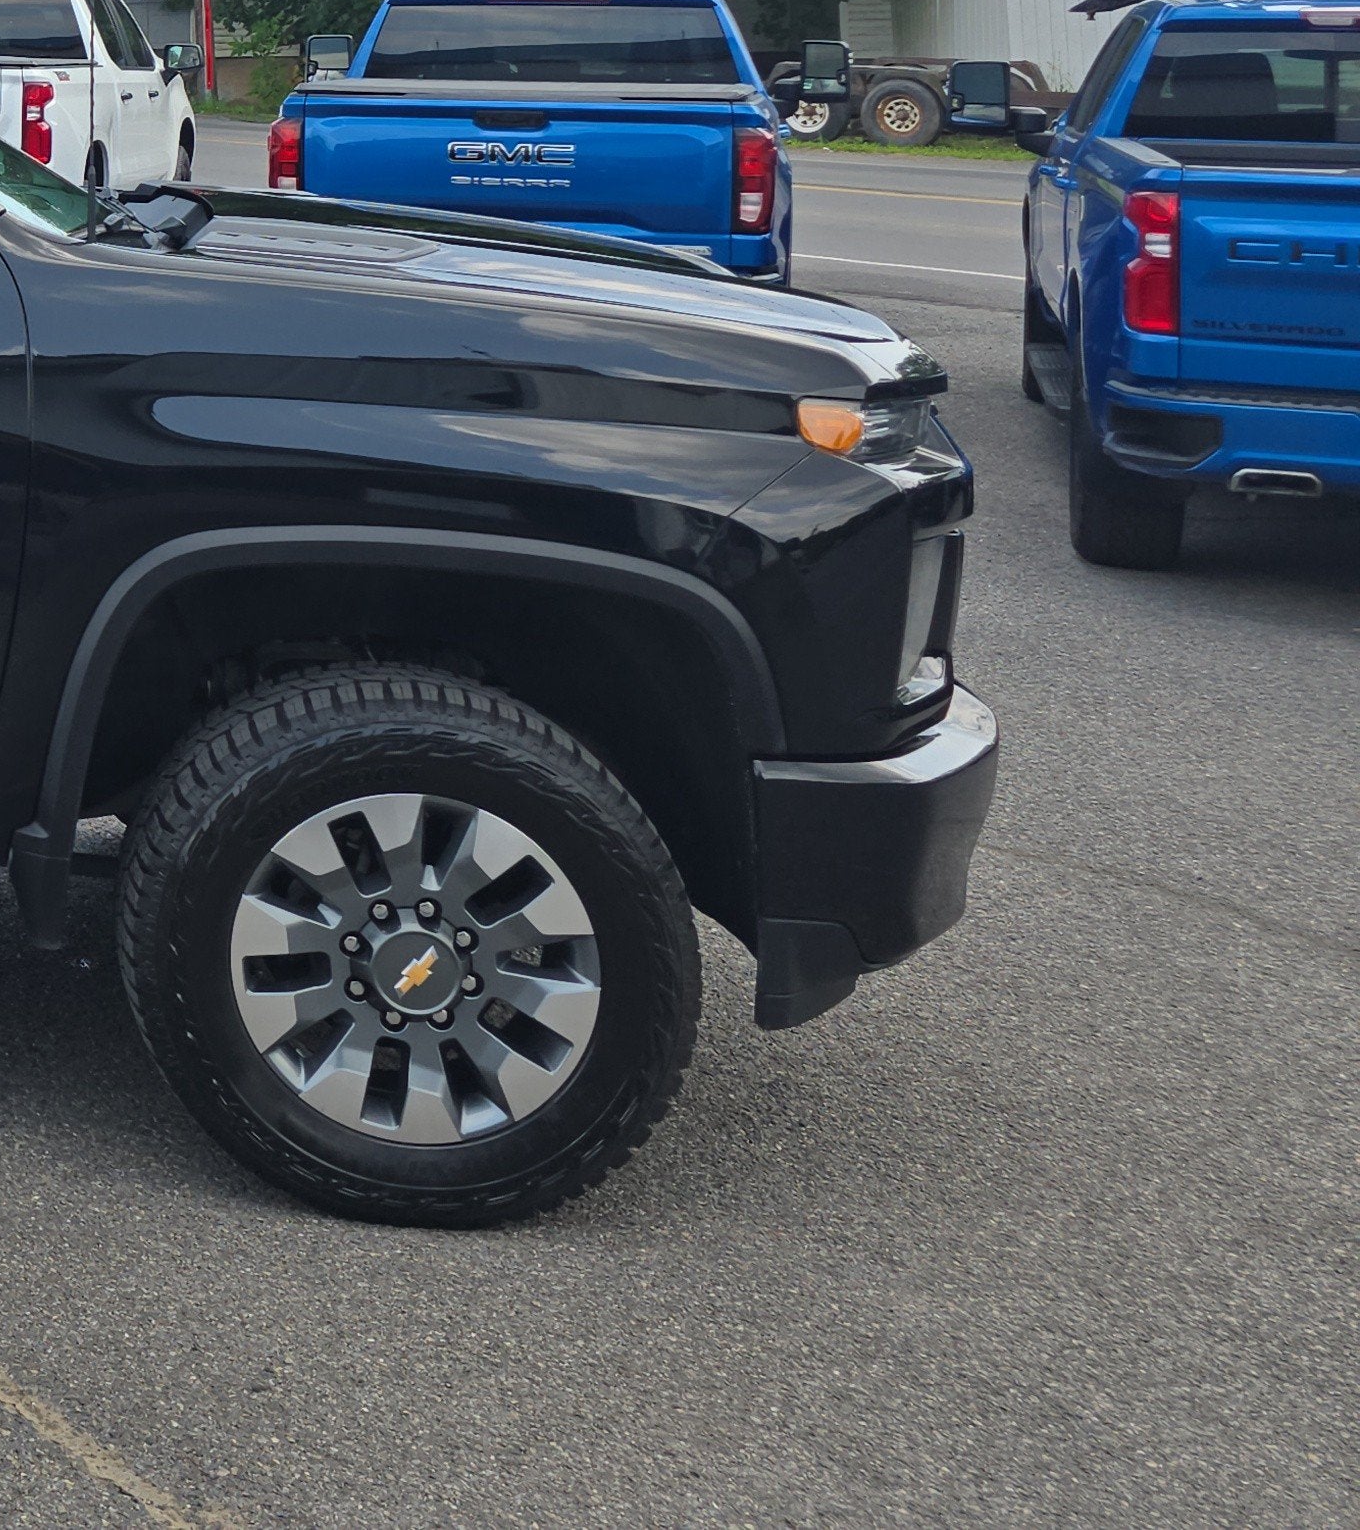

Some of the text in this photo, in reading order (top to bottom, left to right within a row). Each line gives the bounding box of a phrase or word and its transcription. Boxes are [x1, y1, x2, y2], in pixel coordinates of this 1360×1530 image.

[448, 141, 576, 167] GMC
[450, 175, 571, 188] SIERRA
[1227, 238, 1360, 268] CH
[1193, 320, 1346, 336] SILVERADO
